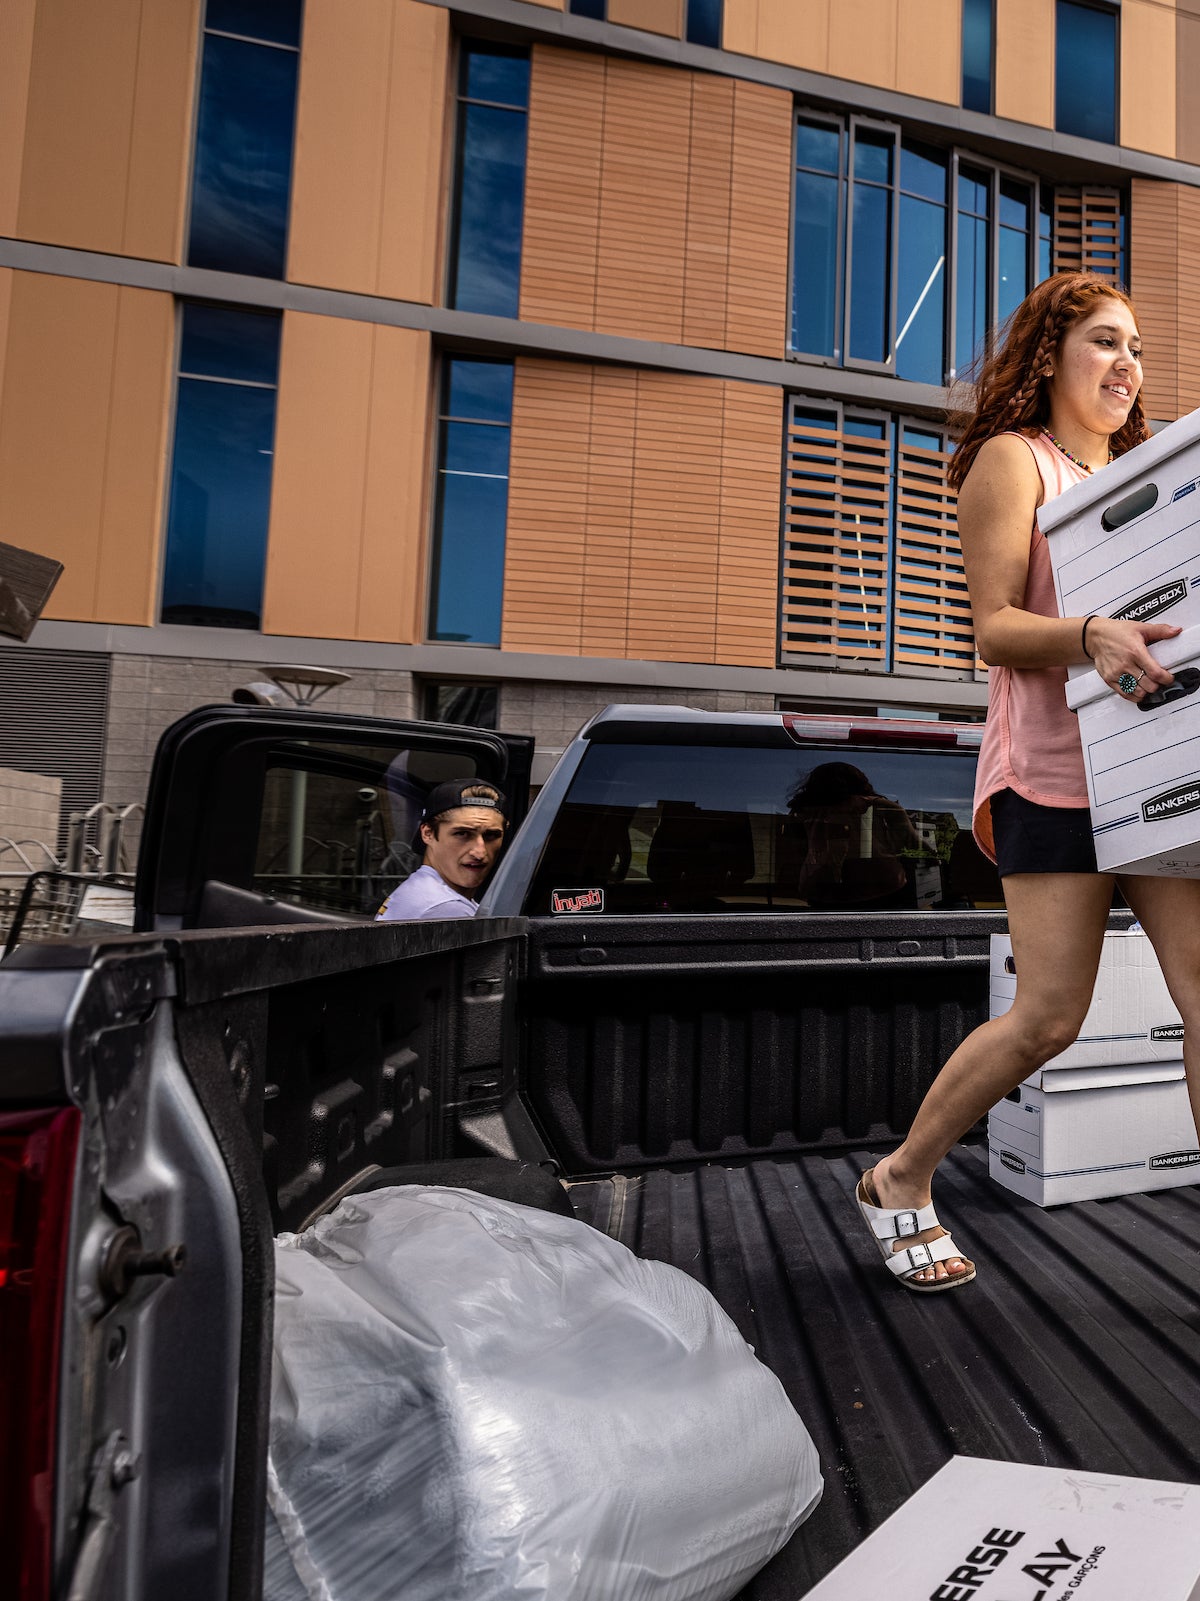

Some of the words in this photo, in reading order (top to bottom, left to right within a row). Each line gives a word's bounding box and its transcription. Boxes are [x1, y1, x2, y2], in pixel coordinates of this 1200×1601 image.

[1115, 598, 1159, 621] ANKERS
[1159, 586, 1183, 604] BOX
[1147, 790, 1200, 815] BANKERS
[553, 889, 601, 911] inyati
[1153, 1155, 1188, 1166] BANKERS
[1068, 1545, 1106, 1588] GARÇONS
